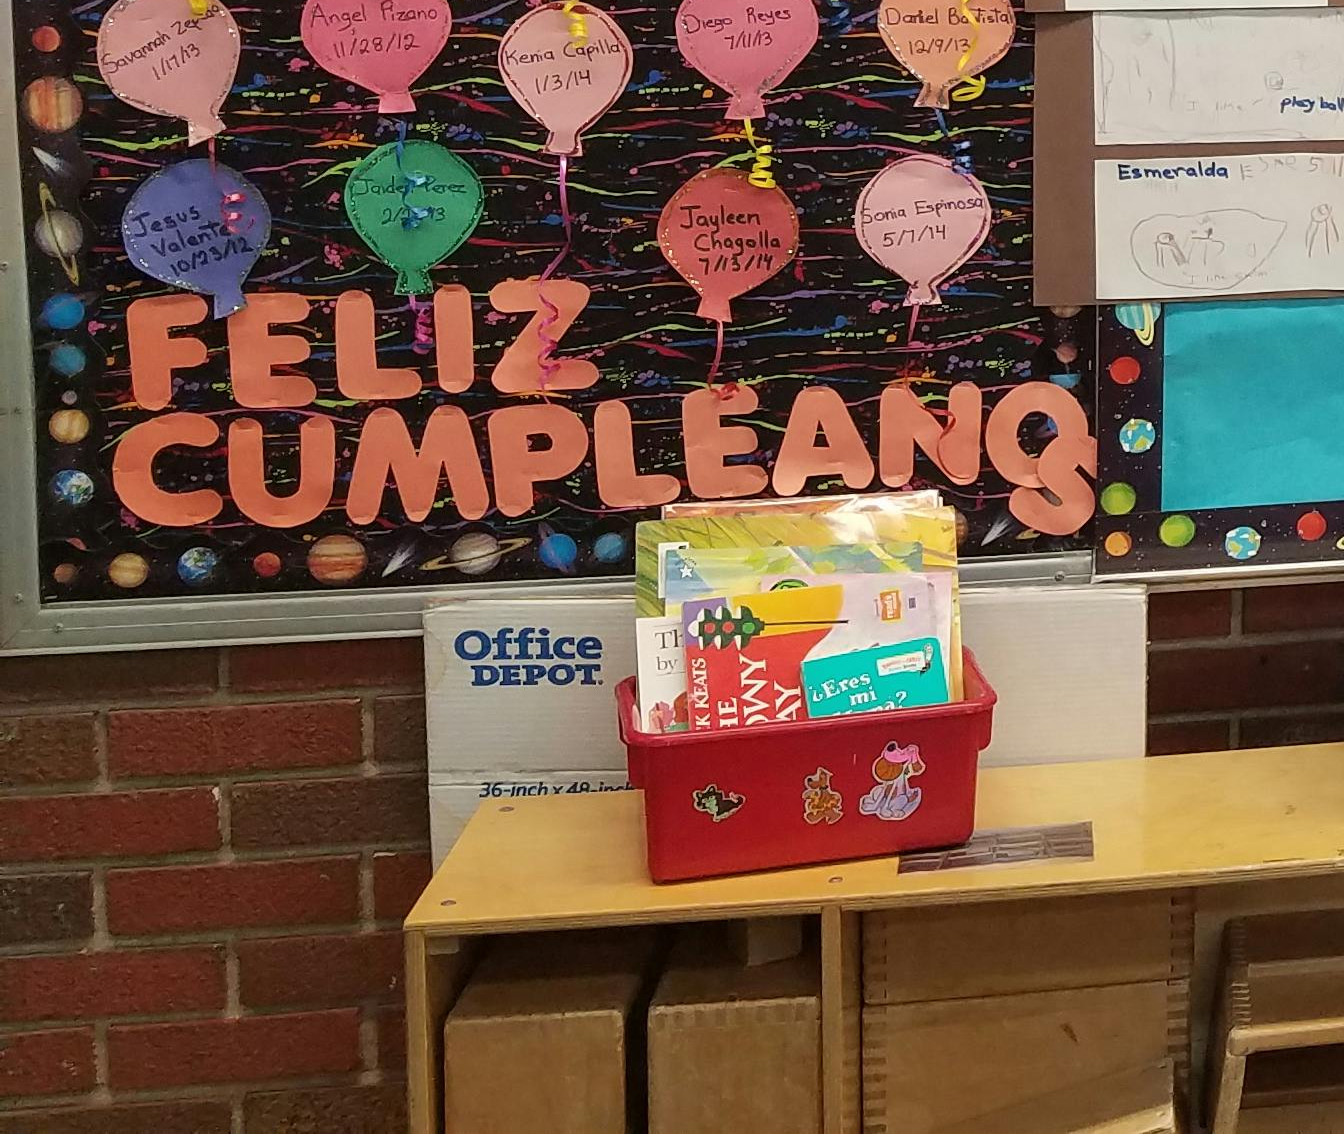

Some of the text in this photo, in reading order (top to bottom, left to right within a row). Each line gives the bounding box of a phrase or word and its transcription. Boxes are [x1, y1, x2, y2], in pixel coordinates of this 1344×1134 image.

[308, 0, 438, 34] Angel Pizano
[682, 5, 794, 34] Diego Reyes
[885, 5, 940, 28] Daniel
[100, 28, 171, 74] Savannah
[333, 31, 420, 58] 11/28/12
[722, 28, 775, 50] 7/11/13
[907, 37, 972, 57] 12/9/13
[152, 43, 202, 81] 1/17/13
[504, 40, 623, 67] Kenia Capilla
[533, 70, 592, 93] 1/3/14
[1279, 96, 1316, 114] play
[1117, 160, 1230, 181] Esmeralda
[130, 203, 202, 239] Jesus
[678, 205, 762, 233] Jayleen
[861, 192, 985, 226] Sonia Espinosa
[150, 221, 228, 257] Valente
[693, 230, 782, 255] Chagolla
[881, 223, 948, 249] 5/7/14
[168, 237, 254, 276] 10/23/12
[697, 253, 775, 276] 7/13/14
[125, 279, 601, 412] FELIZ
[453, 628, 603, 662] Office
[656, 657, 678, 674] by
[692, 657, 710, 708] KEATS
[808, 674, 871, 703] ¿Eres
[850, 690, 877, 706] mi
[478, 780, 564, 798] 36-inch x
